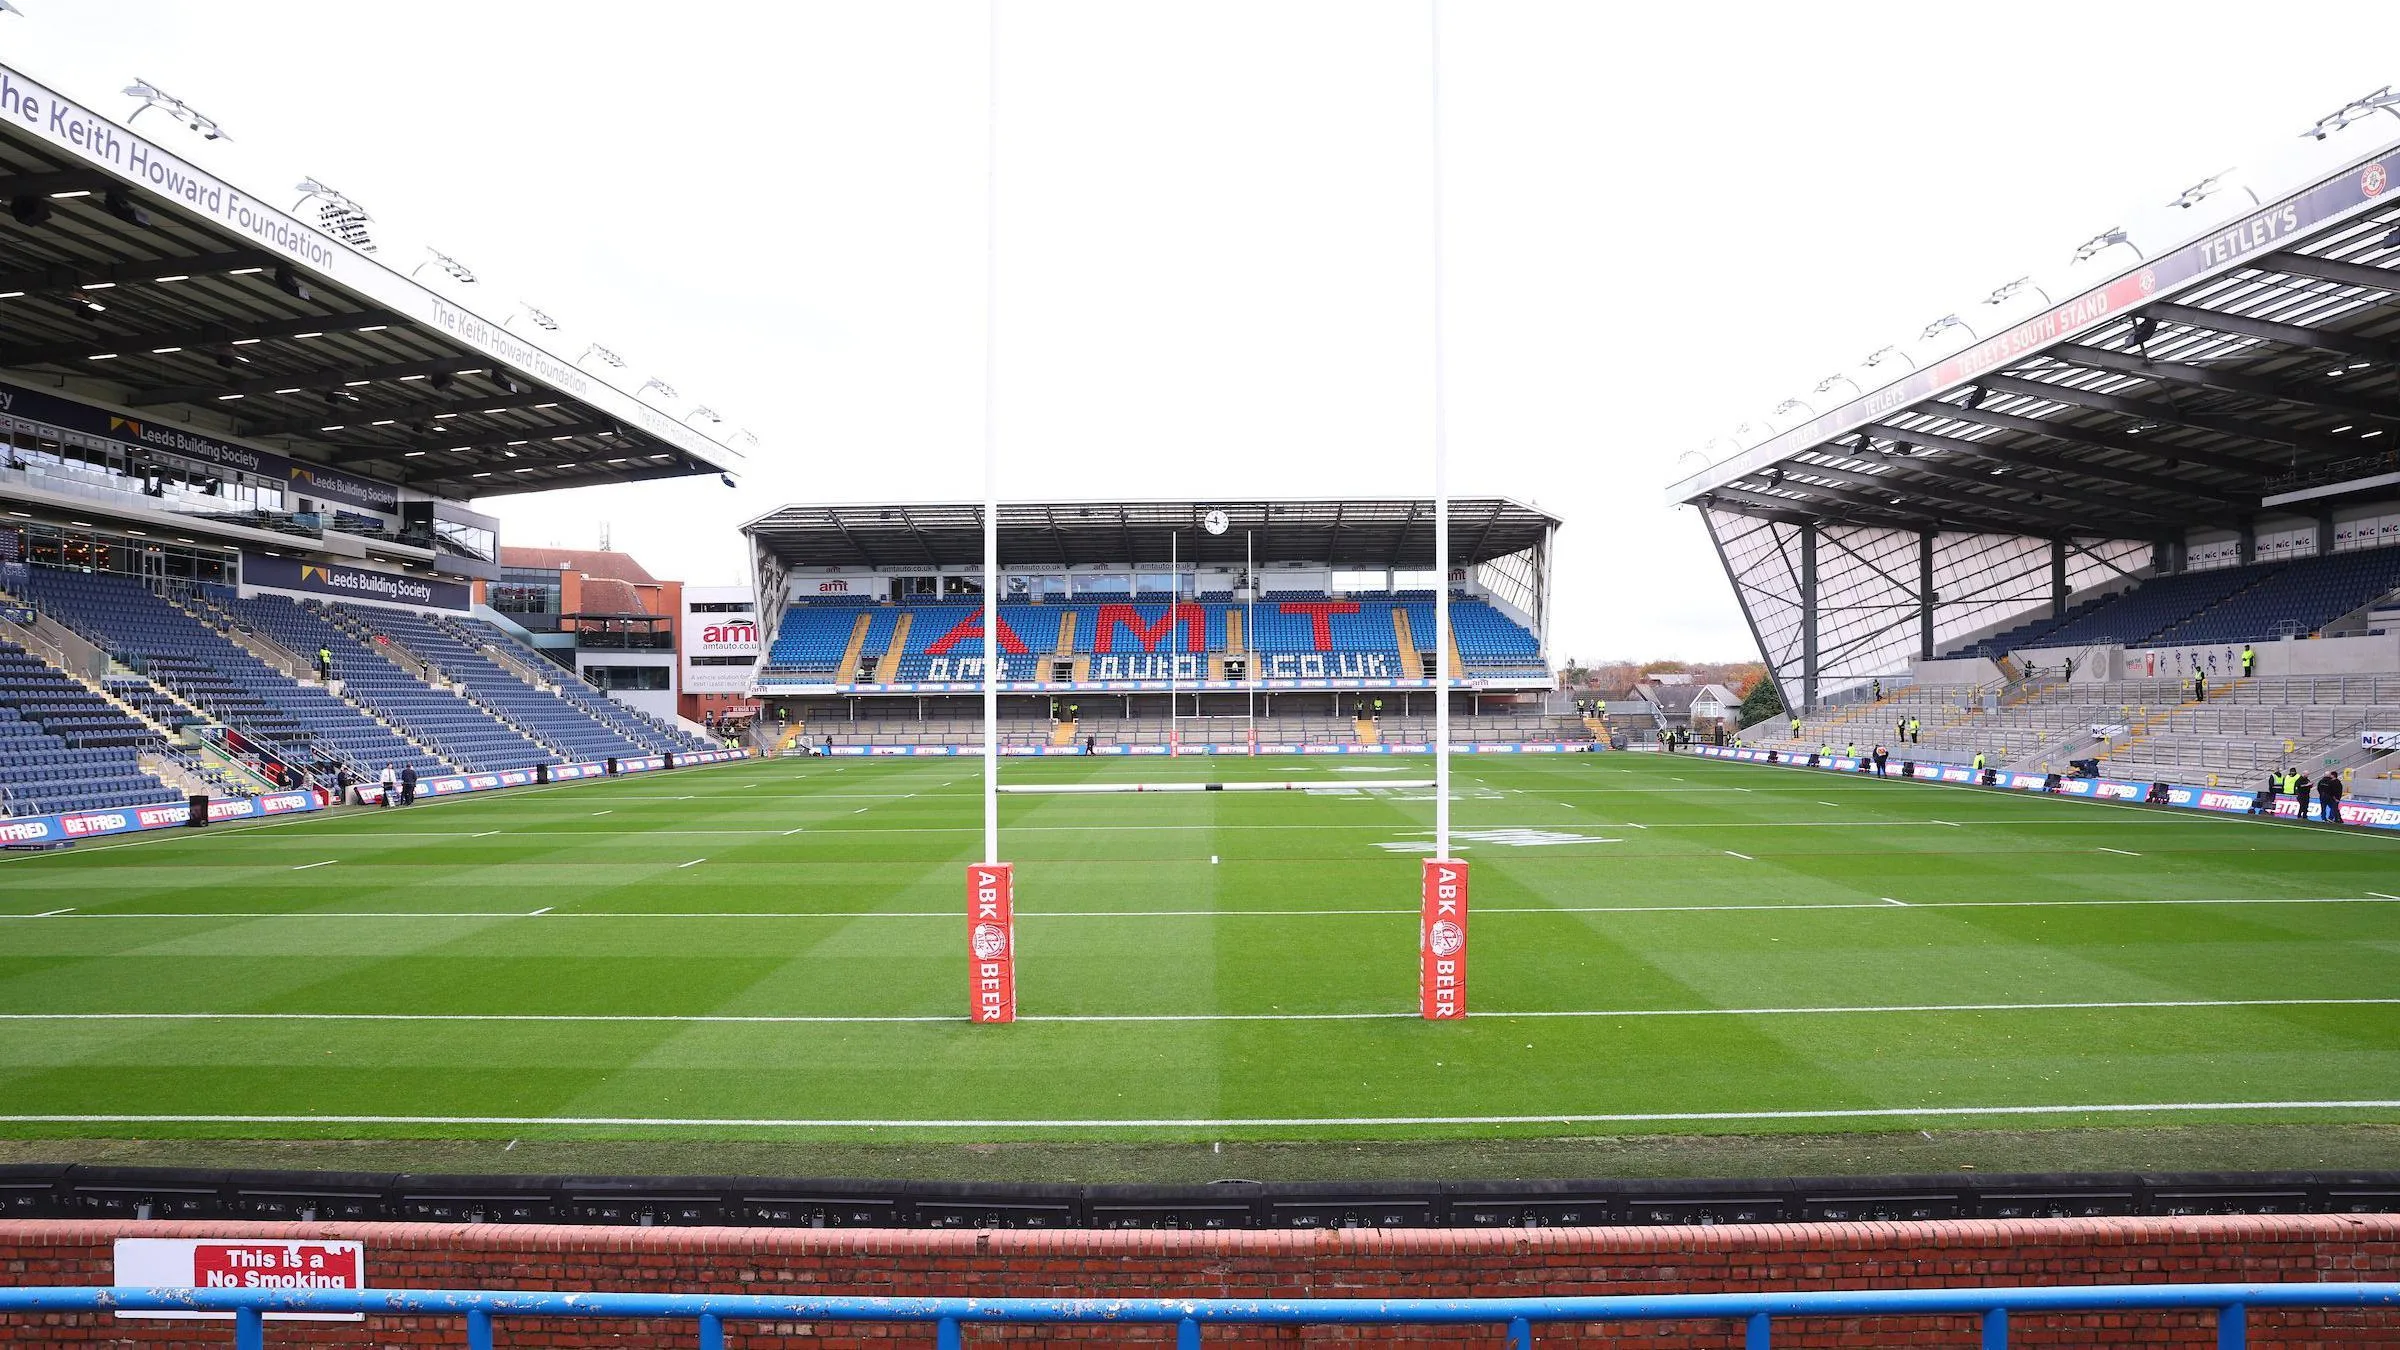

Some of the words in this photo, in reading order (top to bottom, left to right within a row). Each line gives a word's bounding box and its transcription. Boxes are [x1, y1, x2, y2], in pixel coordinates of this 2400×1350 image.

[0, 72, 39, 123] he
[49, 99, 120, 164] Keith
[129, 142, 219, 214] Howard
[227, 193, 333, 270] Foundation
[2201, 204, 2297, 268] TETLEY'S
[432, 298, 455, 329] The
[458, 314, 488, 345] Keith
[491, 331, 533, 367] Howard
[535, 352, 587, 395] Foundation
[1956, 337, 2009, 378] TETLEY'S
[2013, 317, 2056, 348] SOUTH
[2060, 293, 2107, 329] STAND
[139, 424, 175, 449] Leeds
[177, 435, 220, 462] Building
[221, 445, 260, 470] Society
[311, 473, 336, 491] Leeds
[336, 480, 367, 501] Building
[367, 487, 395, 507] Society
[1141, 562, 1191, 571] amtauto.o.uk
[327, 568, 358, 589] Leeds
[360, 573, 397, 598] Building
[398, 580, 431, 602] Society
[819, 580, 848, 592] amt
[2363, 733, 2384, 744] NiC
[264, 795, 307, 811] BETFRED
[2099, 783, 2138, 798] BETFRED
[2200, 790, 2252, 810] BETFRED
[208, 799, 254, 817] BETFRED
[2340, 805, 2400, 825] BETFRED
[65, 814, 126, 834] BETFRED
[978, 870, 997, 919] ABK
[1438, 867, 1457, 917] ABK
[980, 962, 1001, 1022] BEER
[1436, 960, 1456, 1019] BEER
[226, 1249, 276, 1268] This
[282, 1250, 302, 1268] is
[309, 1255, 324, 1268] a
[206, 1270, 238, 1288] No
[245, 1270, 345, 1289] Smoking
